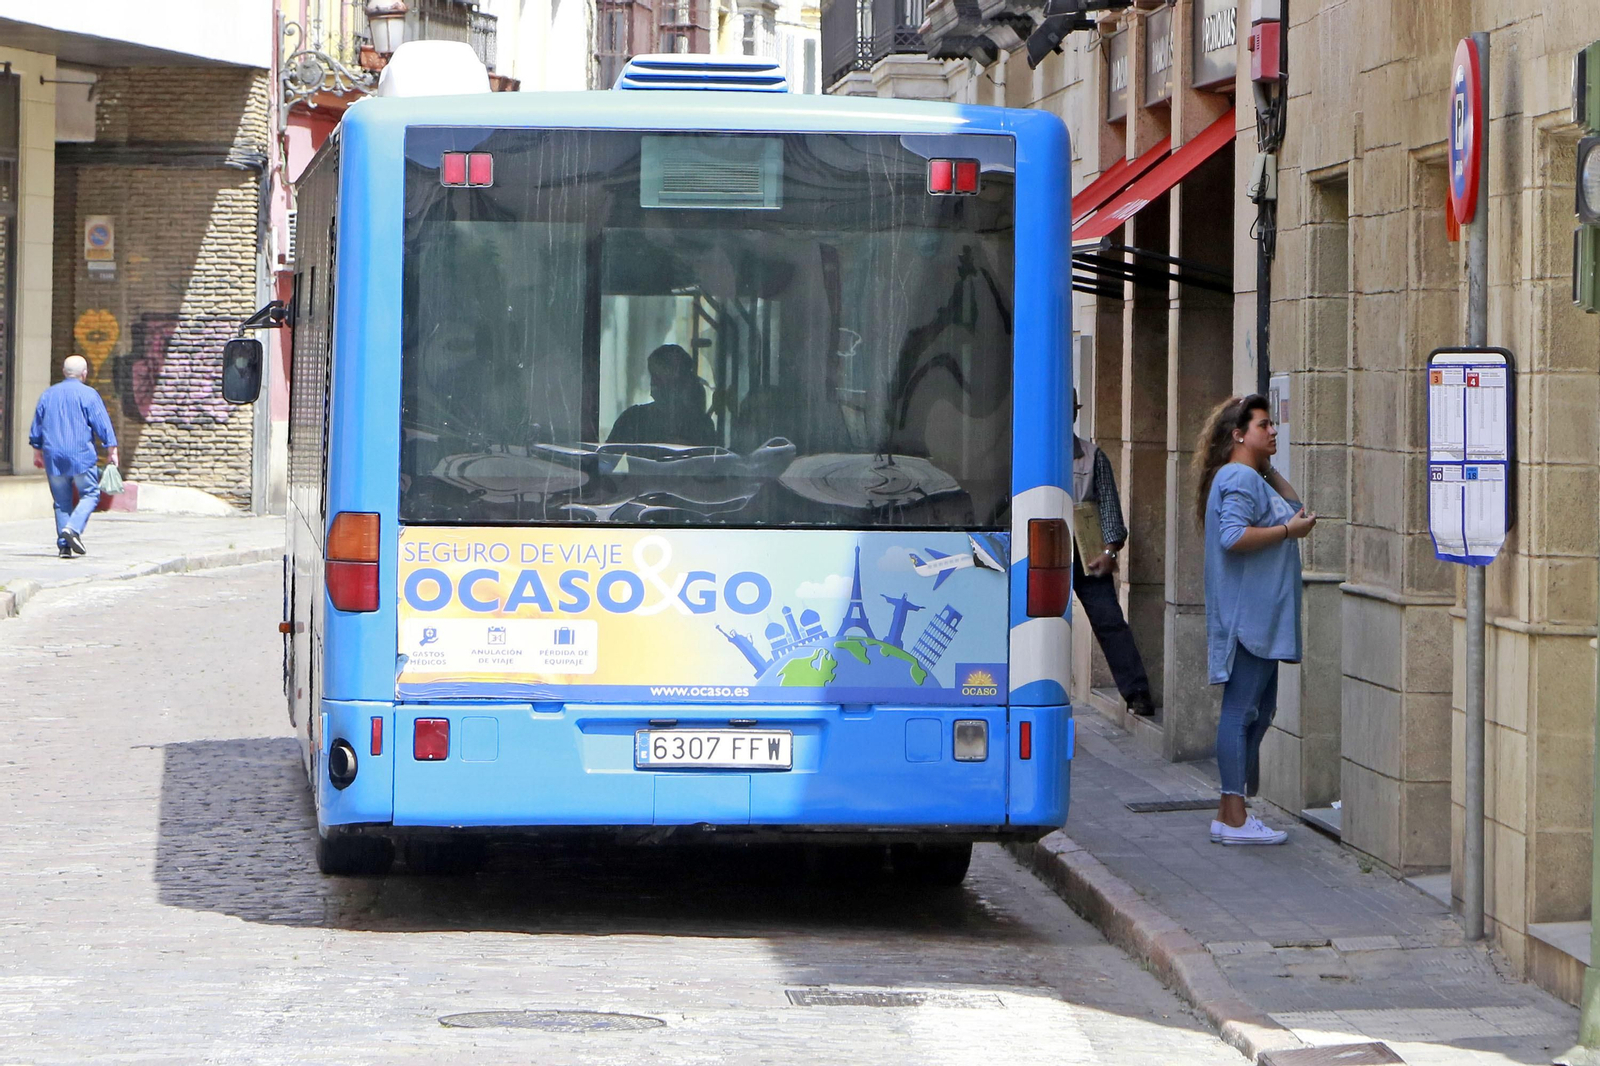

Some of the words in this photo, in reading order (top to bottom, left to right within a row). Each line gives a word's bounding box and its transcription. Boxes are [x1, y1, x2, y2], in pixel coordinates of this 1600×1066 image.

[1456, 99, 1463, 144] P
[1434, 375, 1439, 383] 3
[1470, 378, 1476, 386] 4
[1432, 472, 1442, 480] 10
[1467, 472, 1477, 480] 18
[404, 541, 510, 564] SEGURO
[520, 543, 554, 564] DE
[558, 543, 623, 570] VIAJE
[403, 567, 645, 614] OCASO
[677, 570, 773, 615] GO
[471, 648, 523, 656] ANULACIÓN
[539, 648, 574, 656] PÉRDIDA
[577, 649, 589, 657] DE
[409, 658, 447, 666] MÉDICOS
[491, 657, 514, 665] VIAJE
[544, 658, 584, 667] EQUIPAJE
[650, 686, 750, 697] www.ocaso.es
[961, 687, 997, 696] OCASO
[653, 736, 721, 760] 6307
[732, 737, 781, 761] FFW
